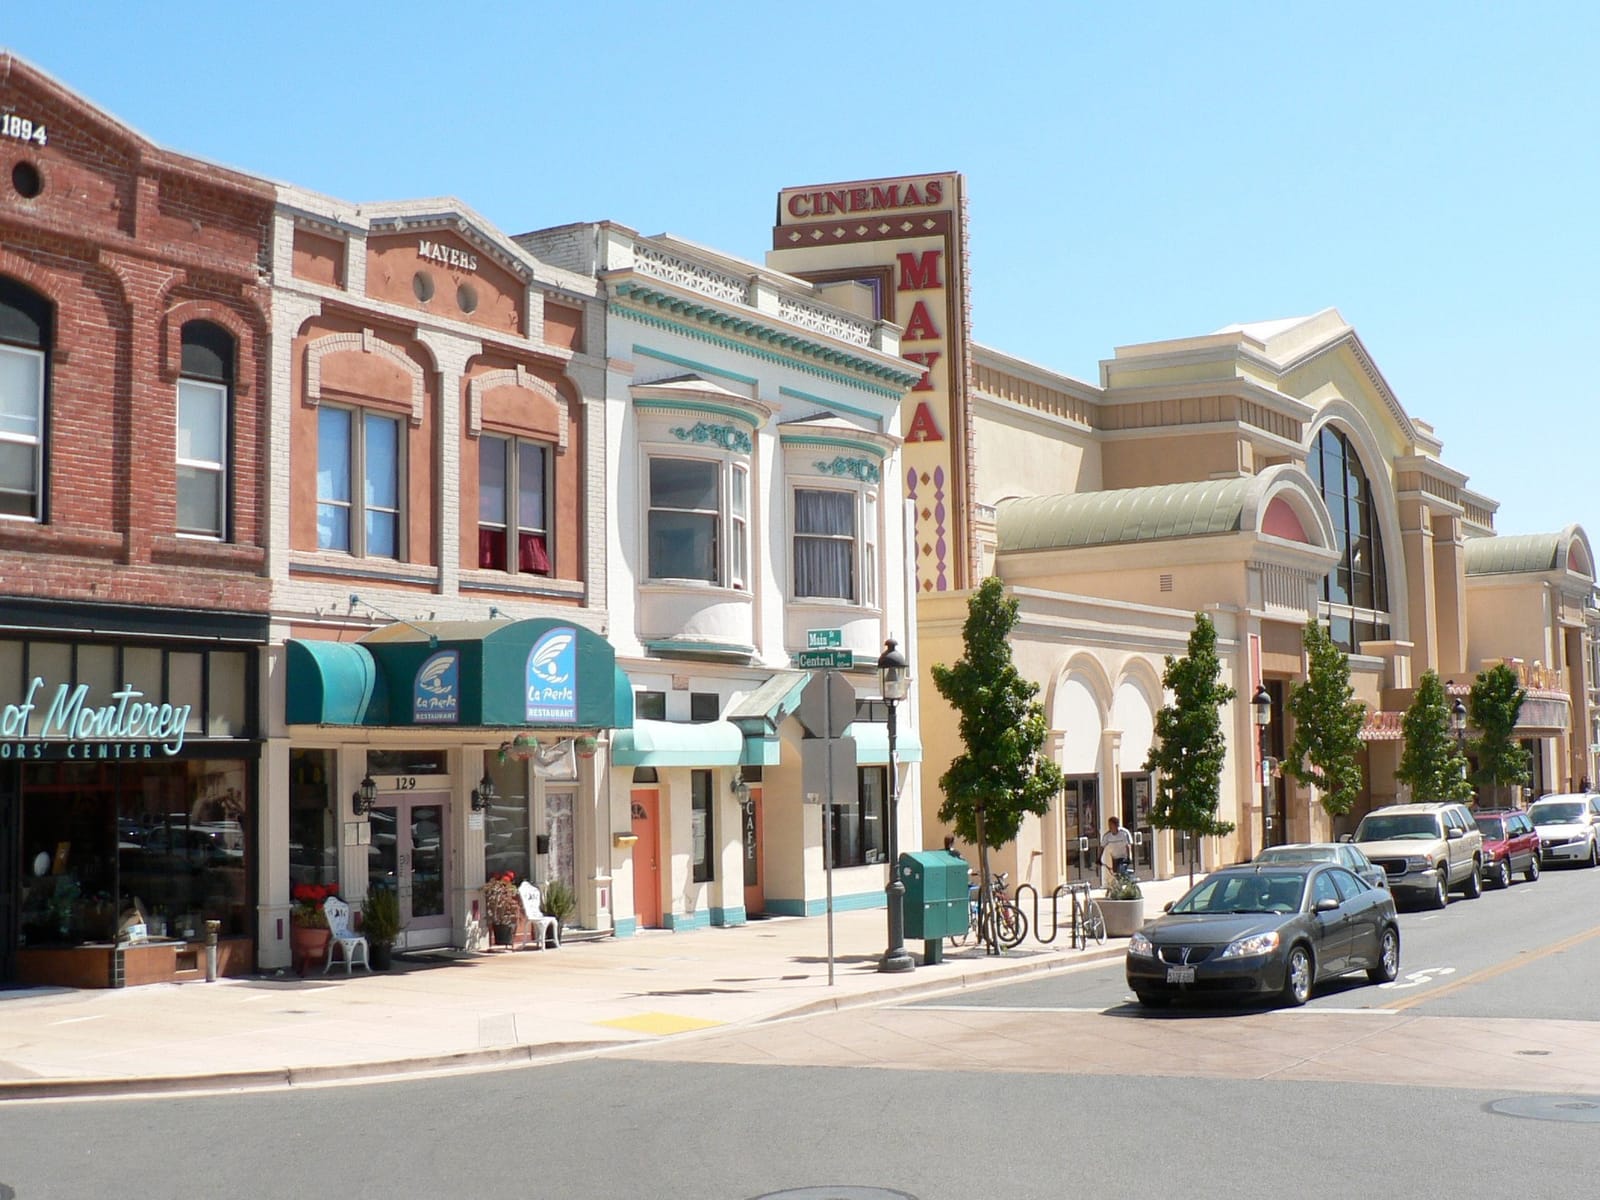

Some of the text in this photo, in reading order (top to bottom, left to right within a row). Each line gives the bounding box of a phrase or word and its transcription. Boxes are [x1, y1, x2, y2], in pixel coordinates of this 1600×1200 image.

[2, 114, 47, 145] 1894
[787, 180, 943, 218] CINEMAS
[418, 239, 478, 271] MAYERS
[896, 250, 945, 444] MAYA
[800, 653, 835, 668] Central
[416, 696, 428, 708] La
[528, 685, 573, 702] La Perla
[2, 676, 192, 757] of Monterey
[416, 712, 456, 721] RESTAURANT
[528, 708, 573, 718] RESTAURANT
[67, 742, 153, 759] CENTER
[396, 776, 416, 790] 129
